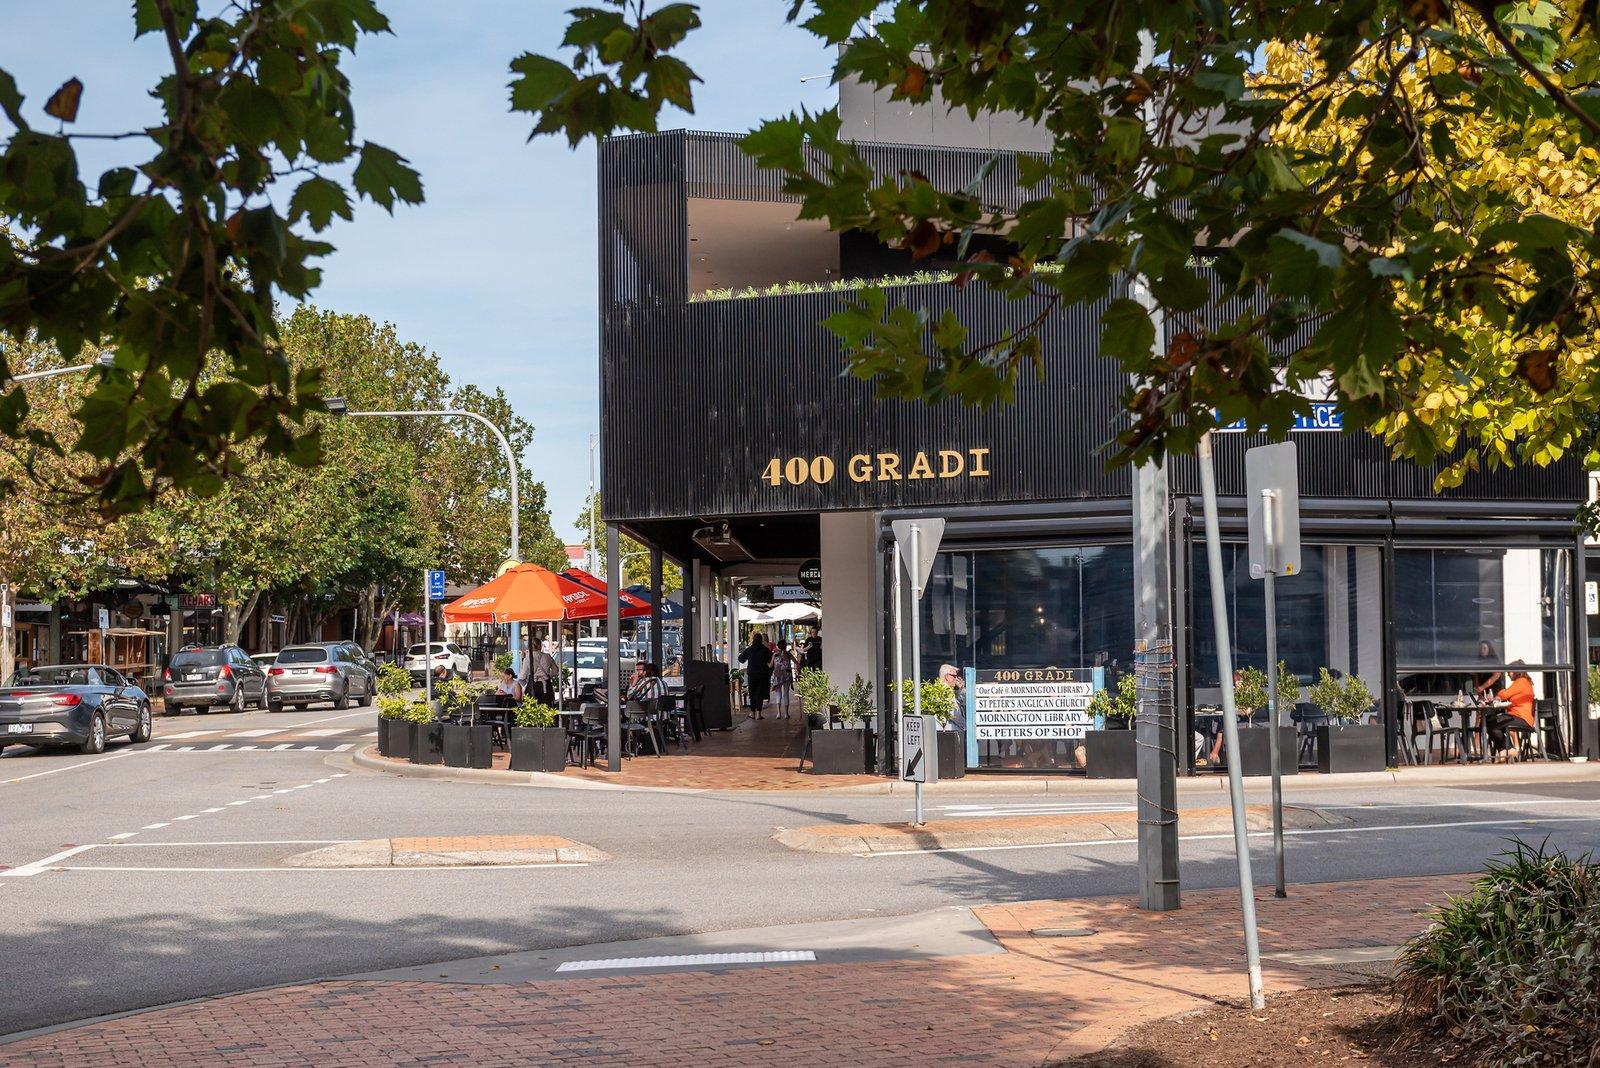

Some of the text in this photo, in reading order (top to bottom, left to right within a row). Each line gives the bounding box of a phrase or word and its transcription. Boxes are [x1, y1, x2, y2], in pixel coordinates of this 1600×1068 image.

[761, 448, 990, 486] 400 GRADI
[993, 670, 1074, 681] 400 GRADI
[1010, 686, 1056, 694] MORNINGTON
[1057, 685, 1084, 694] LIBRARY
[1016, 699, 1055, 708] ANGLICAN
[1055, 698, 1085, 708] CHURCH
[979, 713, 1042, 723] MORNINGTON
[906, 721, 920, 732] KEEP
[994, 728, 1033, 737] PETERS
[1035, 727, 1051, 737] OP
[1052, 727, 1082, 737] SHOP
[907, 735, 920, 746] LEFT
